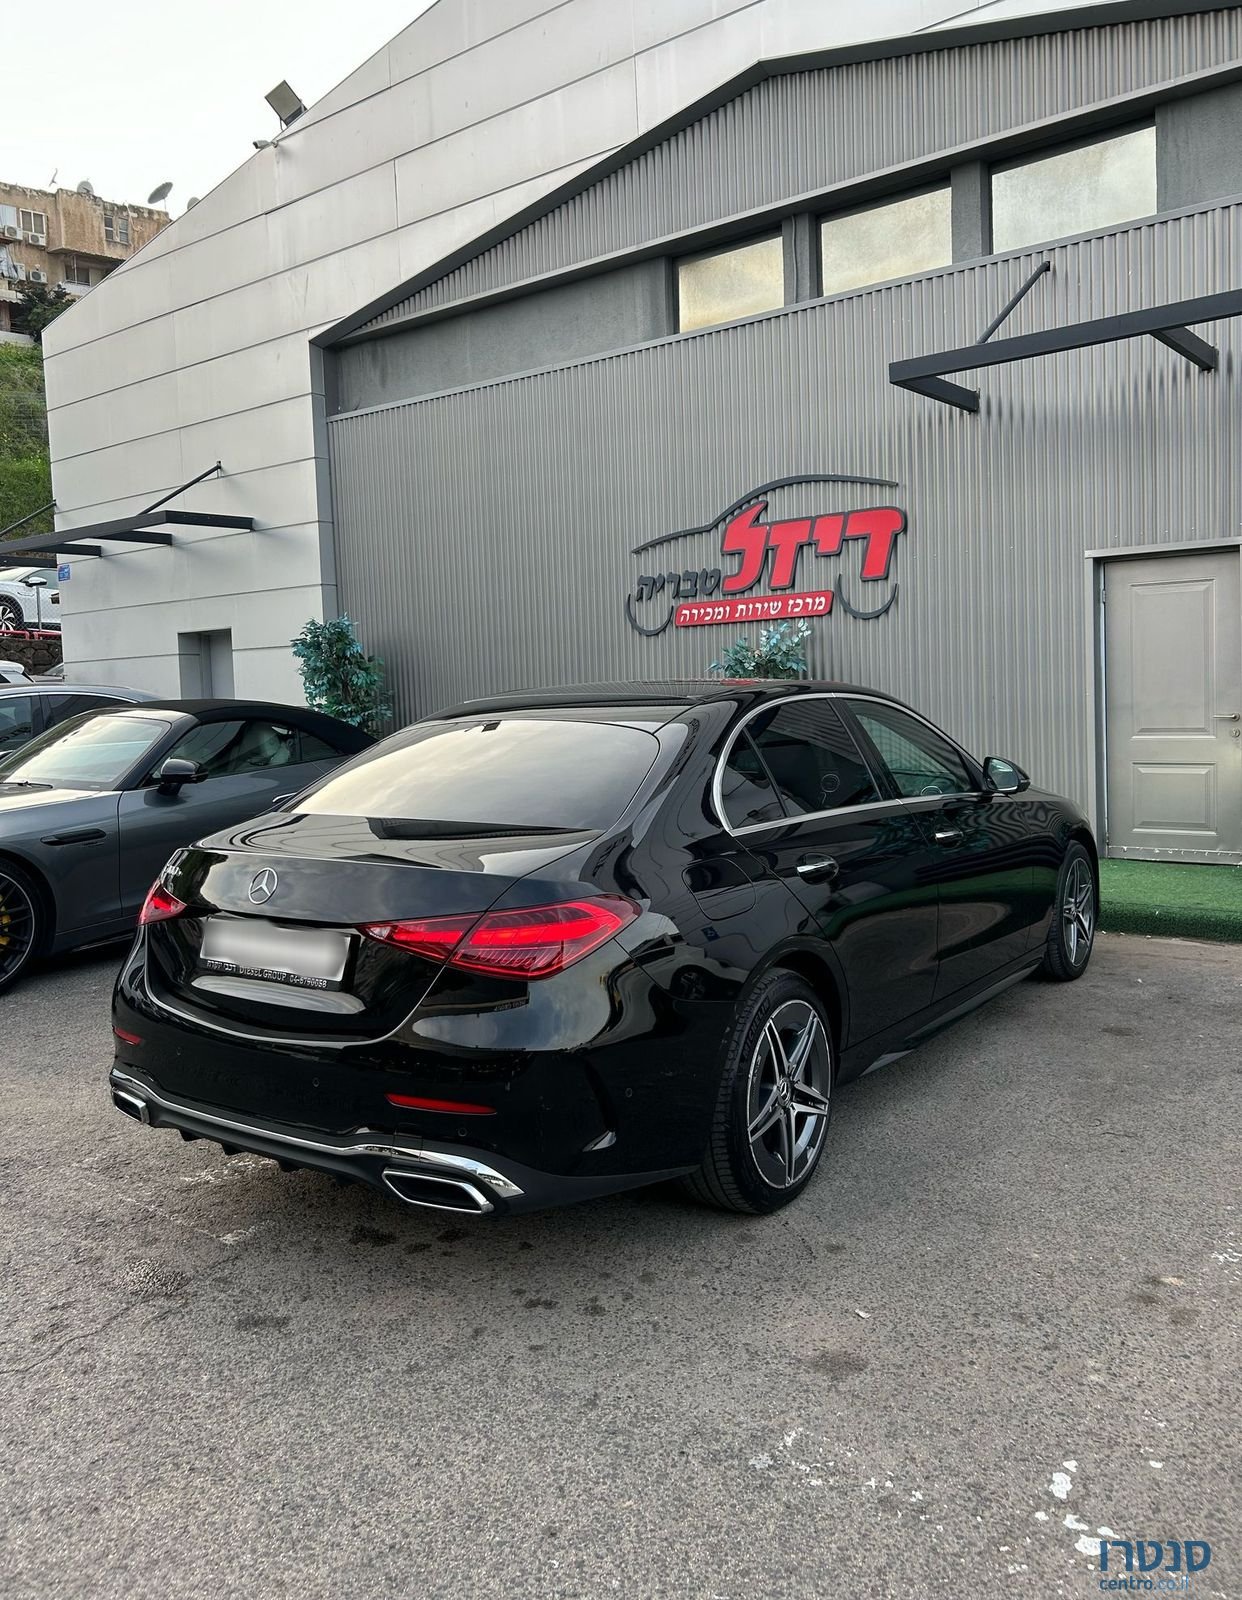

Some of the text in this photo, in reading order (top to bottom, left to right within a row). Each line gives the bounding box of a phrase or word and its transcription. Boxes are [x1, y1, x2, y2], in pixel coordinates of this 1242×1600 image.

[636, 500, 907, 601] דיזל טבריה
[680, 596, 826, 622] מרכז שירות ומכירה
[240, 966, 262, 977] DIESEL
[262, 969, 288, 982] GROUP
